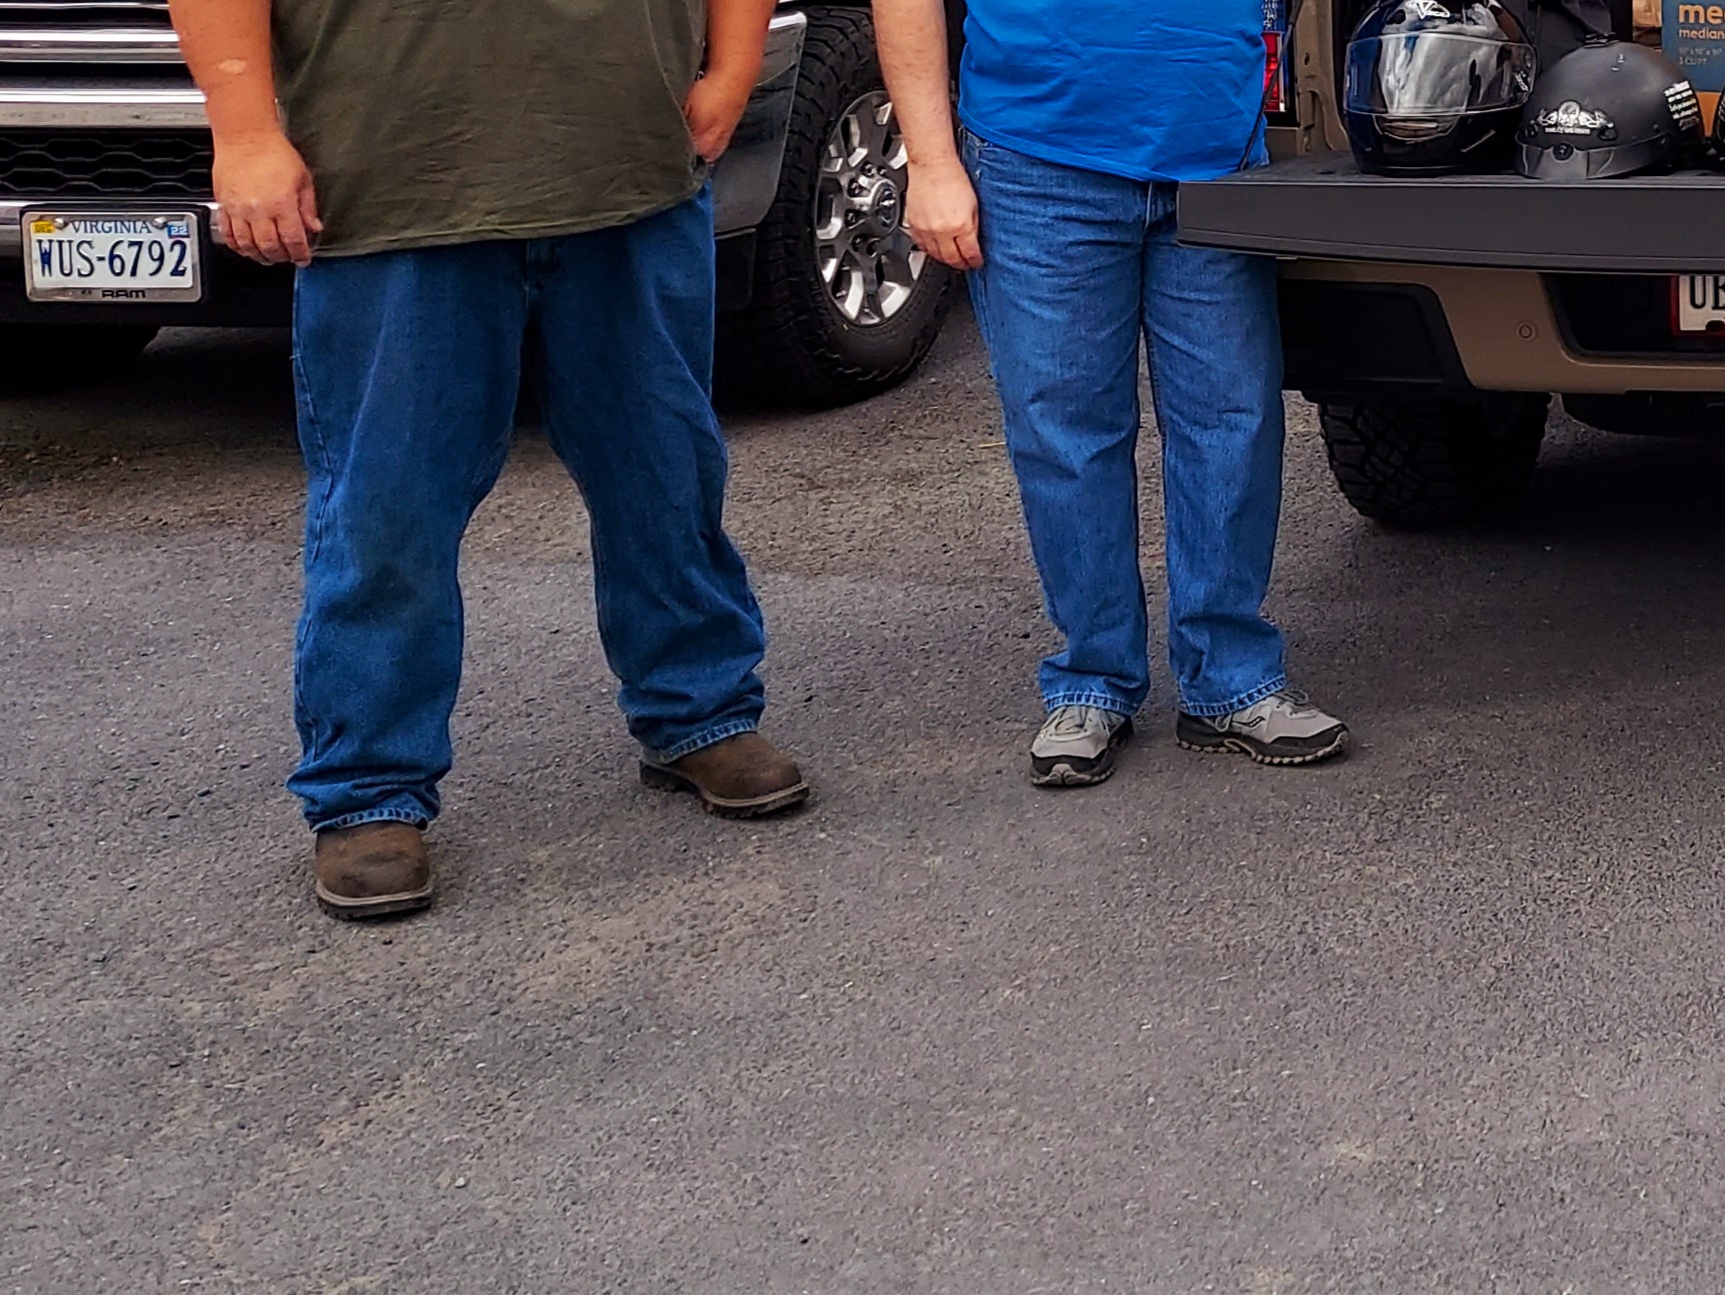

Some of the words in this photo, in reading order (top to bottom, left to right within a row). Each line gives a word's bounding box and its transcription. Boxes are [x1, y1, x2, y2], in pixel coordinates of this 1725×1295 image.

[70, 220, 152, 234] VIRGINIA
[36, 239, 188, 277] WUS-6792
[102, 290, 146, 299] RAM
